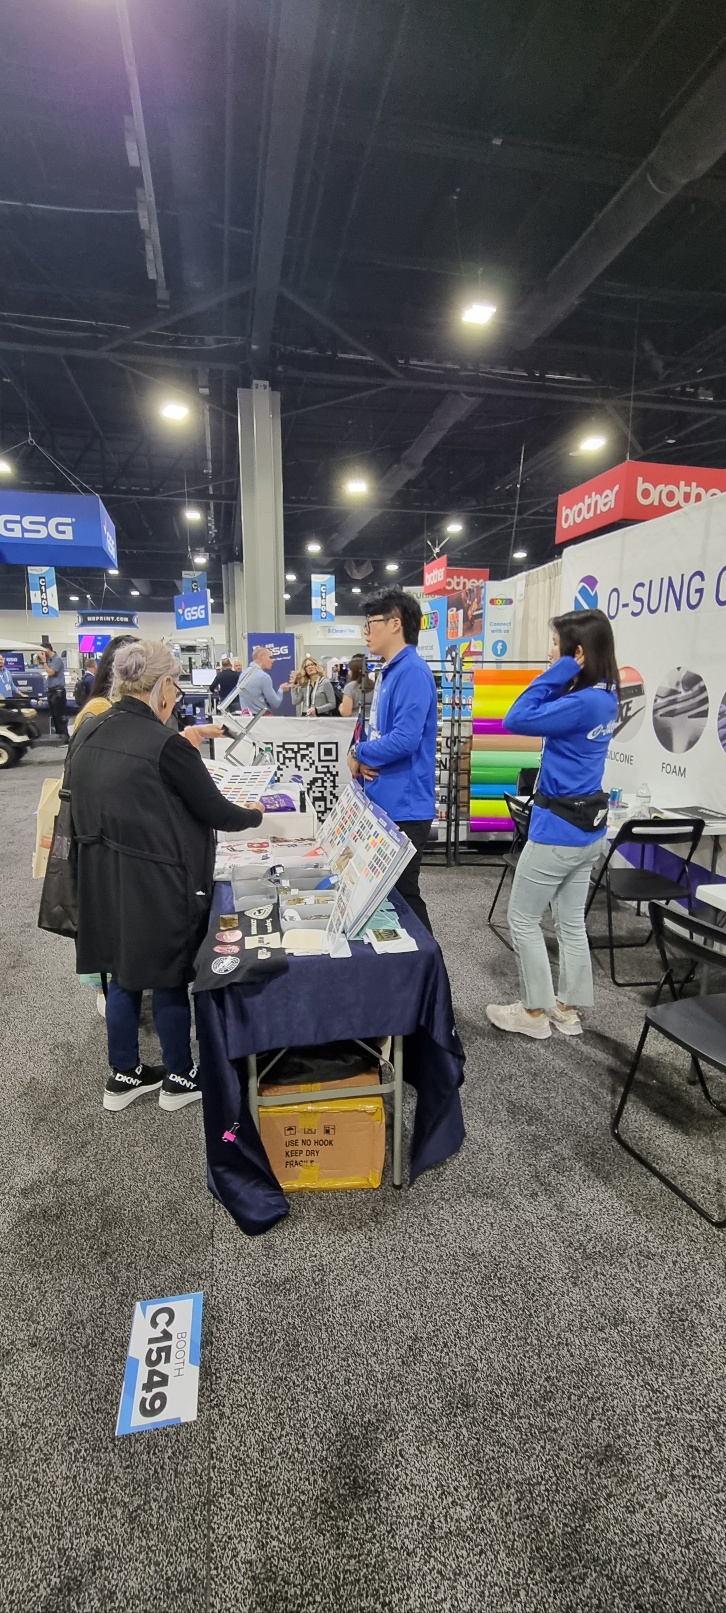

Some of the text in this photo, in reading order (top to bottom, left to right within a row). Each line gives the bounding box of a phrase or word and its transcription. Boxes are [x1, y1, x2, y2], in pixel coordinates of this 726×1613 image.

[561, 484, 620, 529] brother
[425, 567, 445, 587] brother
[39, 578, 49, 615] C1400
[607, 570, 706, 620] O-SUNG
[184, 605, 206, 621] GSG
[661, 762, 687, 778] FOAM
[115, 1073, 143, 1087] DKNY
[168, 1073, 198, 1090] DKNY
[285, 1139, 334, 1148] USE NO HOOK
[285, 1150, 304, 1158] KEEP
[139, 1306, 176, 1419] C1549
[173, 1331, 187, 1378] BOOTH
